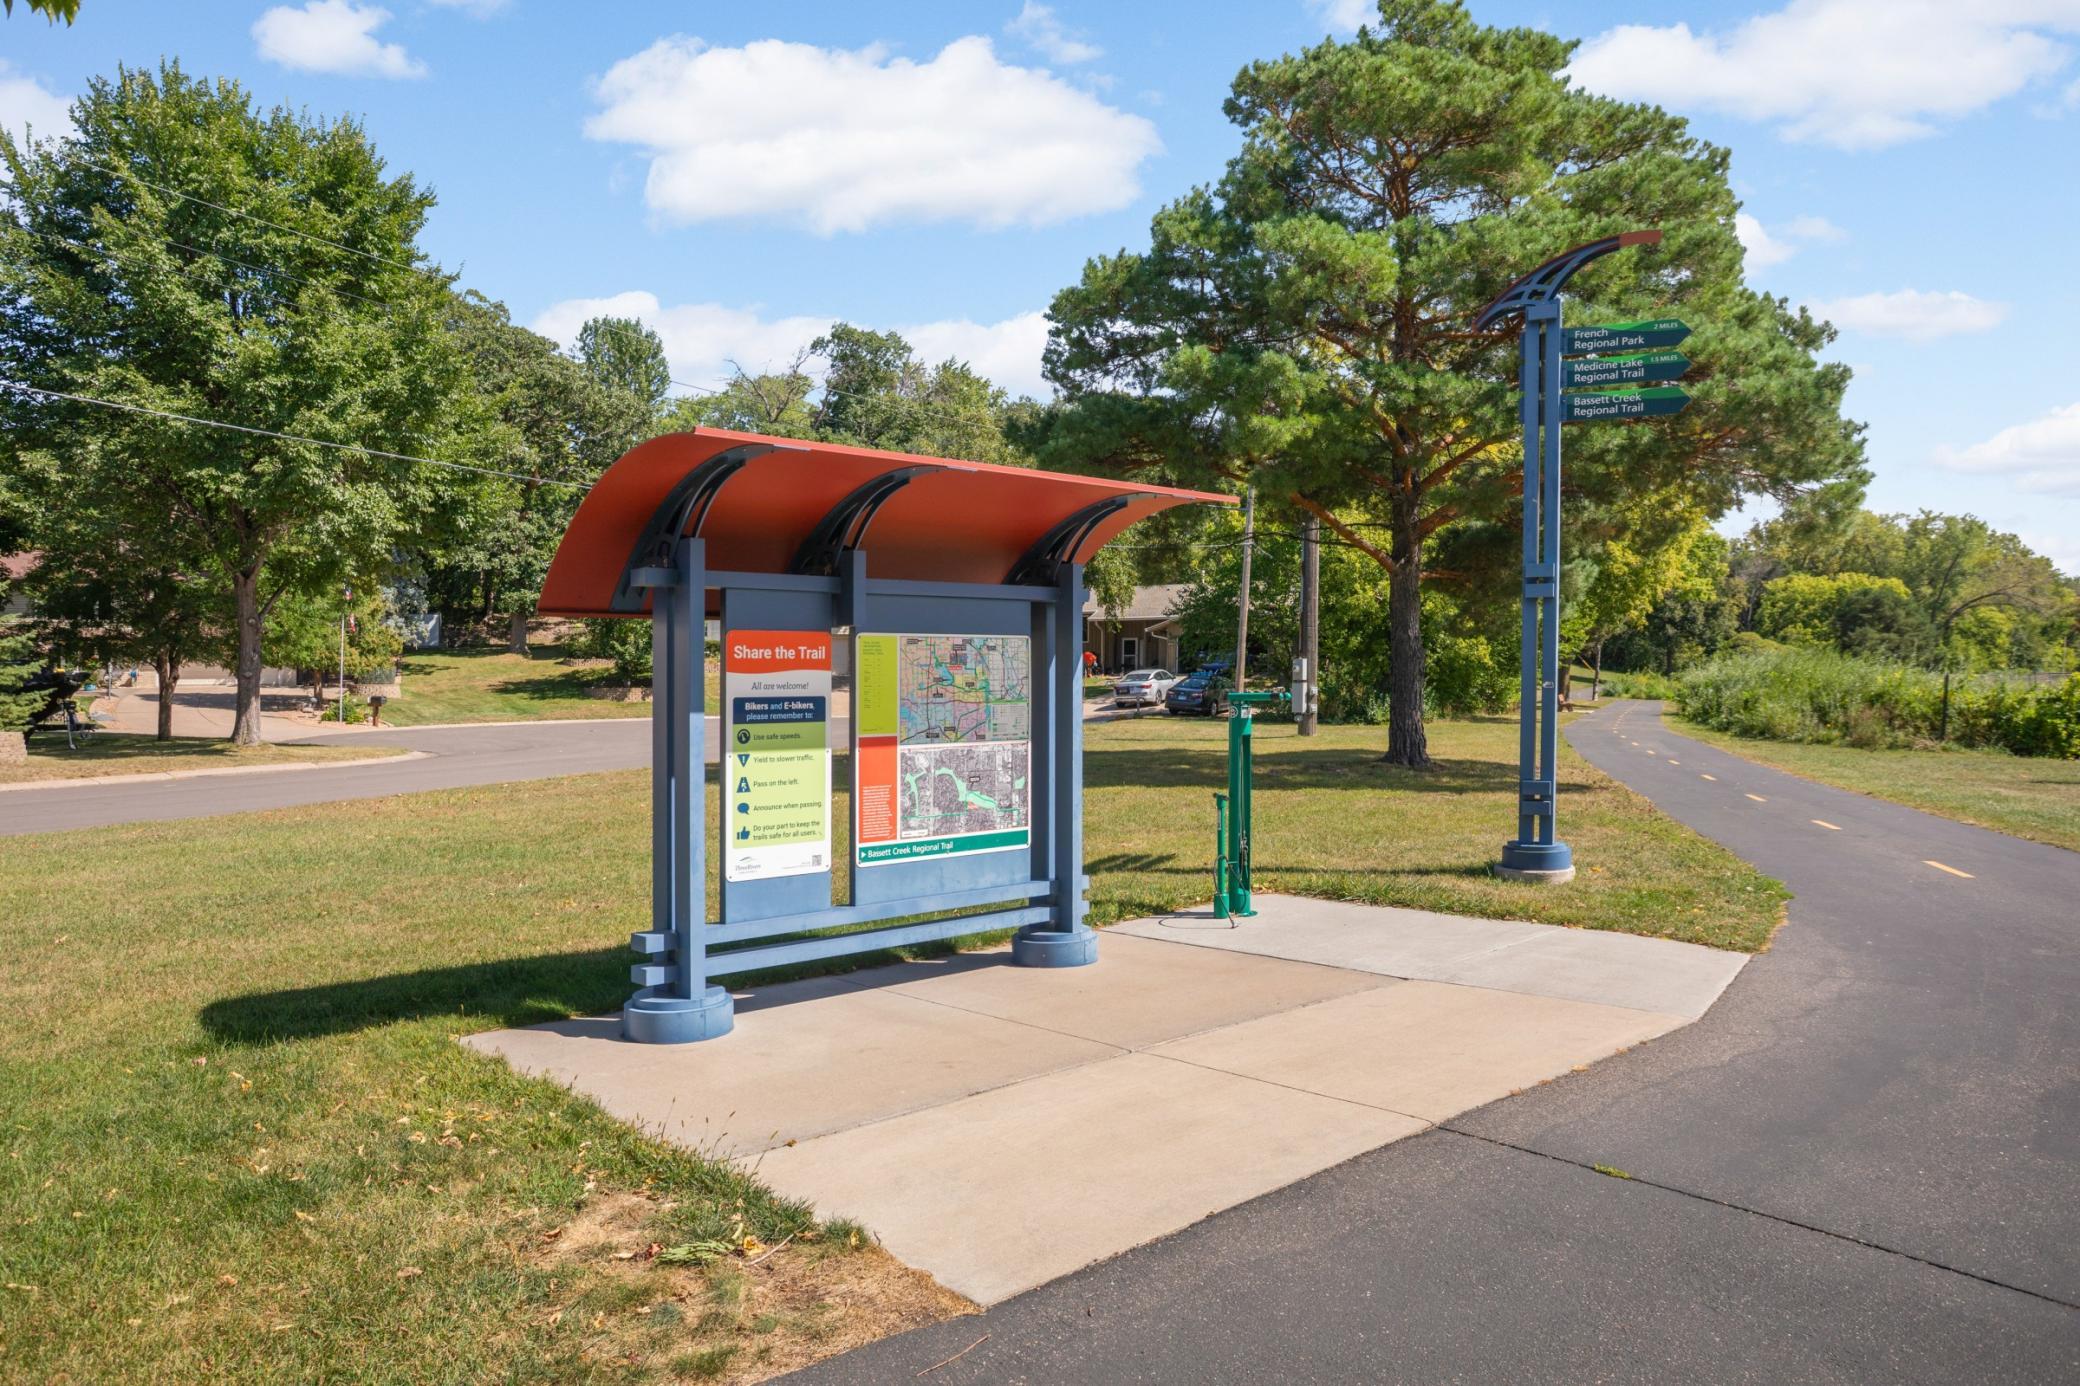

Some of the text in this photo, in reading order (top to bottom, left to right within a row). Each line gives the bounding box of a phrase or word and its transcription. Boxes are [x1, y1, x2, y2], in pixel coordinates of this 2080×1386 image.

[1574, 329, 1608, 338] French
[1574, 336, 1644, 350] Regional Park
[1574, 360, 1643, 372] Medicine Lake
[1574, 368, 1644, 383] Regional Trail
[1574, 393, 1641, 406] Bassett Creek
[1574, 403, 1644, 417] Regional Trail
[734, 645, 826, 659] Share the Trail
[745, 702, 769, 710] Bikers
[784, 702, 814, 710] E-bikers,
[746, 713, 768, 721] please
[776, 823, 788, 831] part
[868, 841, 953, 858] Bassett Creek Regional Trail
